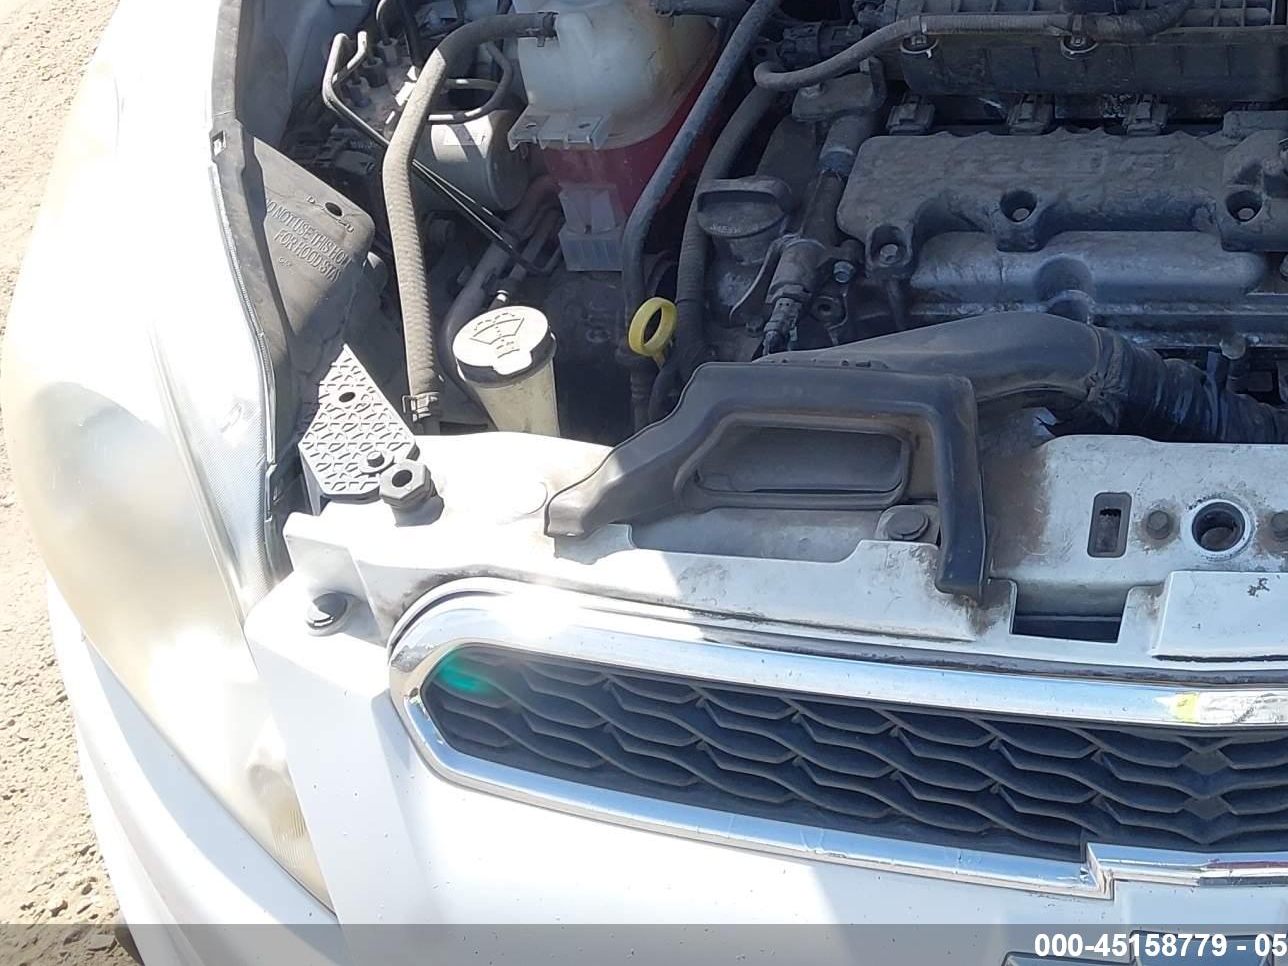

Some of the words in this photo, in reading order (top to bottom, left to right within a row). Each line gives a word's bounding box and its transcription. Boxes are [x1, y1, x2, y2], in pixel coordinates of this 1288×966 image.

[273, 206, 297, 227] NOT
[292, 218, 316, 241] USE
[311, 232, 334, 254] THIS
[274, 228, 298, 251] FOR
[293, 240, 323, 268] HOOD
